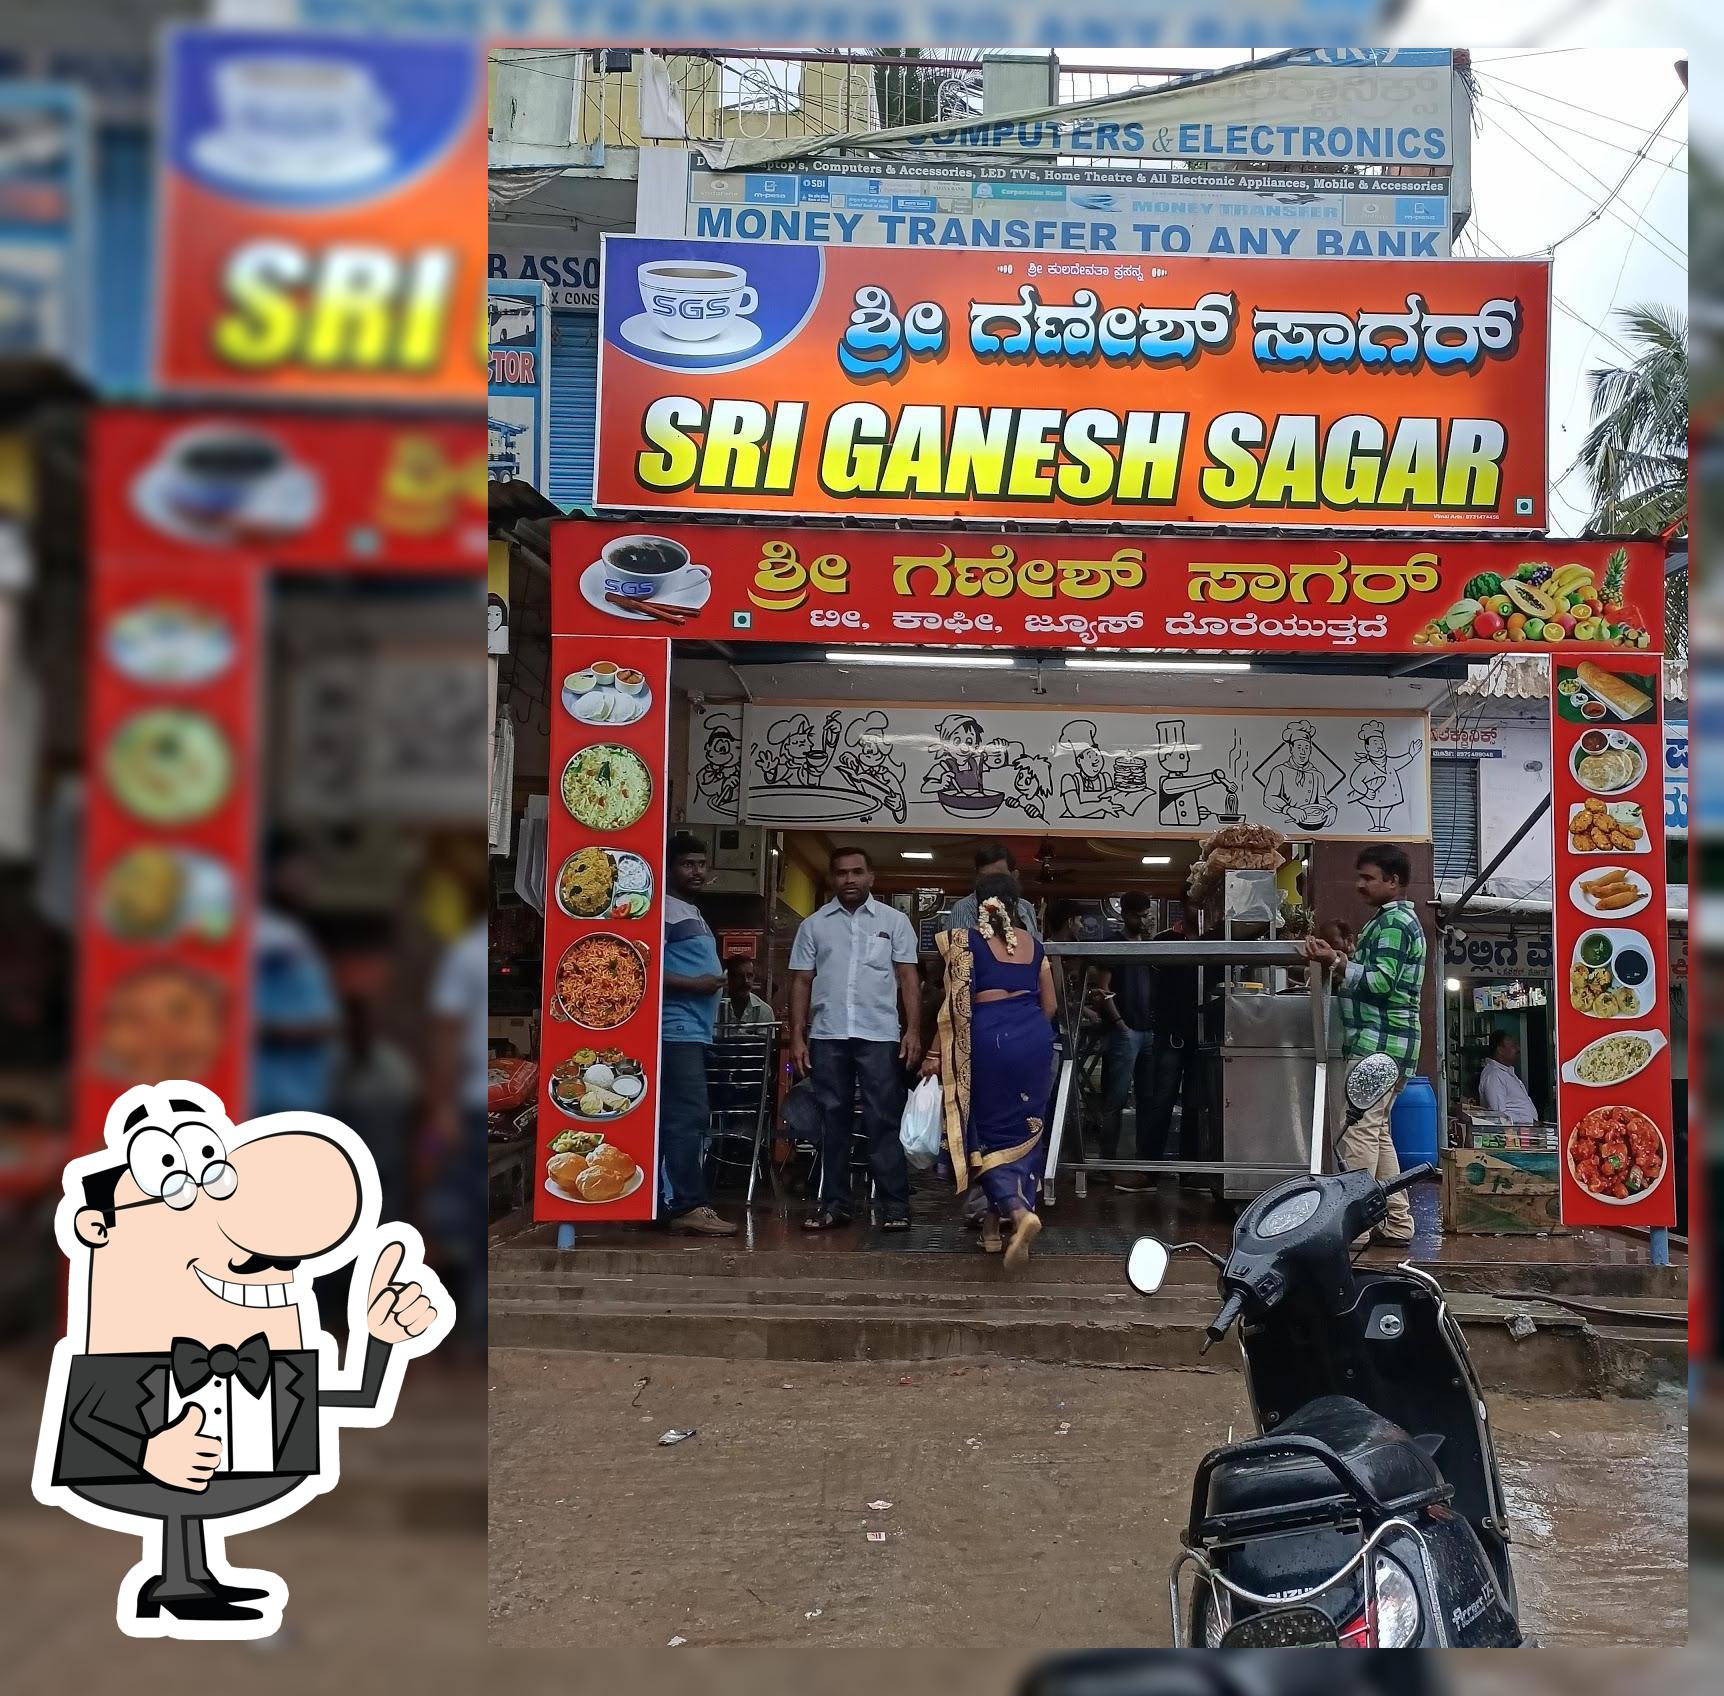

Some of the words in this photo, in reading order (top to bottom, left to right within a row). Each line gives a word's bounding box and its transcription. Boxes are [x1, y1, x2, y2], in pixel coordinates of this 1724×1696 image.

[1152, 127, 1174, 153] &
[1178, 123, 1446, 160] ELECTRONICS
[752, 160, 809, 172] aptop's,
[812, 160, 882, 175] Computers
[885, 164, 896, 175] &
[899, 164, 976, 179] Accessories,
[980, 167, 1007, 179] LED
[1009, 168, 1041, 182] TV's,
[1044, 170, 1080, 182] Home
[1085, 171, 1133, 183] Theatre
[1136, 172, 1147, 183] &
[1150, 172, 1167, 184] All
[1171, 173, 1235, 186] Electronic
[1238, 176, 1310, 189] Appliances,
[1313, 178, 1354, 190] Mobile
[1358, 179, 1369, 190] &
[1372, 180, 1444, 192] Accessories
[811, 179, 826, 188] SBI
[1132, 200, 1214, 215] MONEY
[1219, 203, 1338, 218] TRANSFER
[697, 207, 863, 243] MONEY
[878, 214, 1117, 251] TRANSFER
[1133, 223, 1191, 253] TO
[1207, 226, 1301, 255] ANY
[1316, 229, 1441, 257] BANK
[653, 295, 731, 320] SGS
[837, 284, 946, 380] ಶ್ರೀ
[968, 284, 1236, 362] ಗಣೇಶ್
[1252, 291, 1519, 368] ಸಾಗರ್
[634, 395, 808, 496] SRI
[817, 400, 1191, 505] GANESH
[1198, 410, 1508, 512] SAGAR
[604, 578, 655, 596] SGS
[746, 540, 849, 611] ಶ್ರೀ
[892, 542, 1145, 600] ಗಣೇಶ್
[1186, 550, 1440, 605] ಸಾಗರ್
[810, 609, 870, 630] ಟೀ,
[892, 611, 1003, 634] ಕಾಫೀ,
[1024, 611, 1144, 646] ಜ್ಯೂಸ್
[1165, 612, 1388, 645] ದೊರೆಯುತ್ತದೆ
